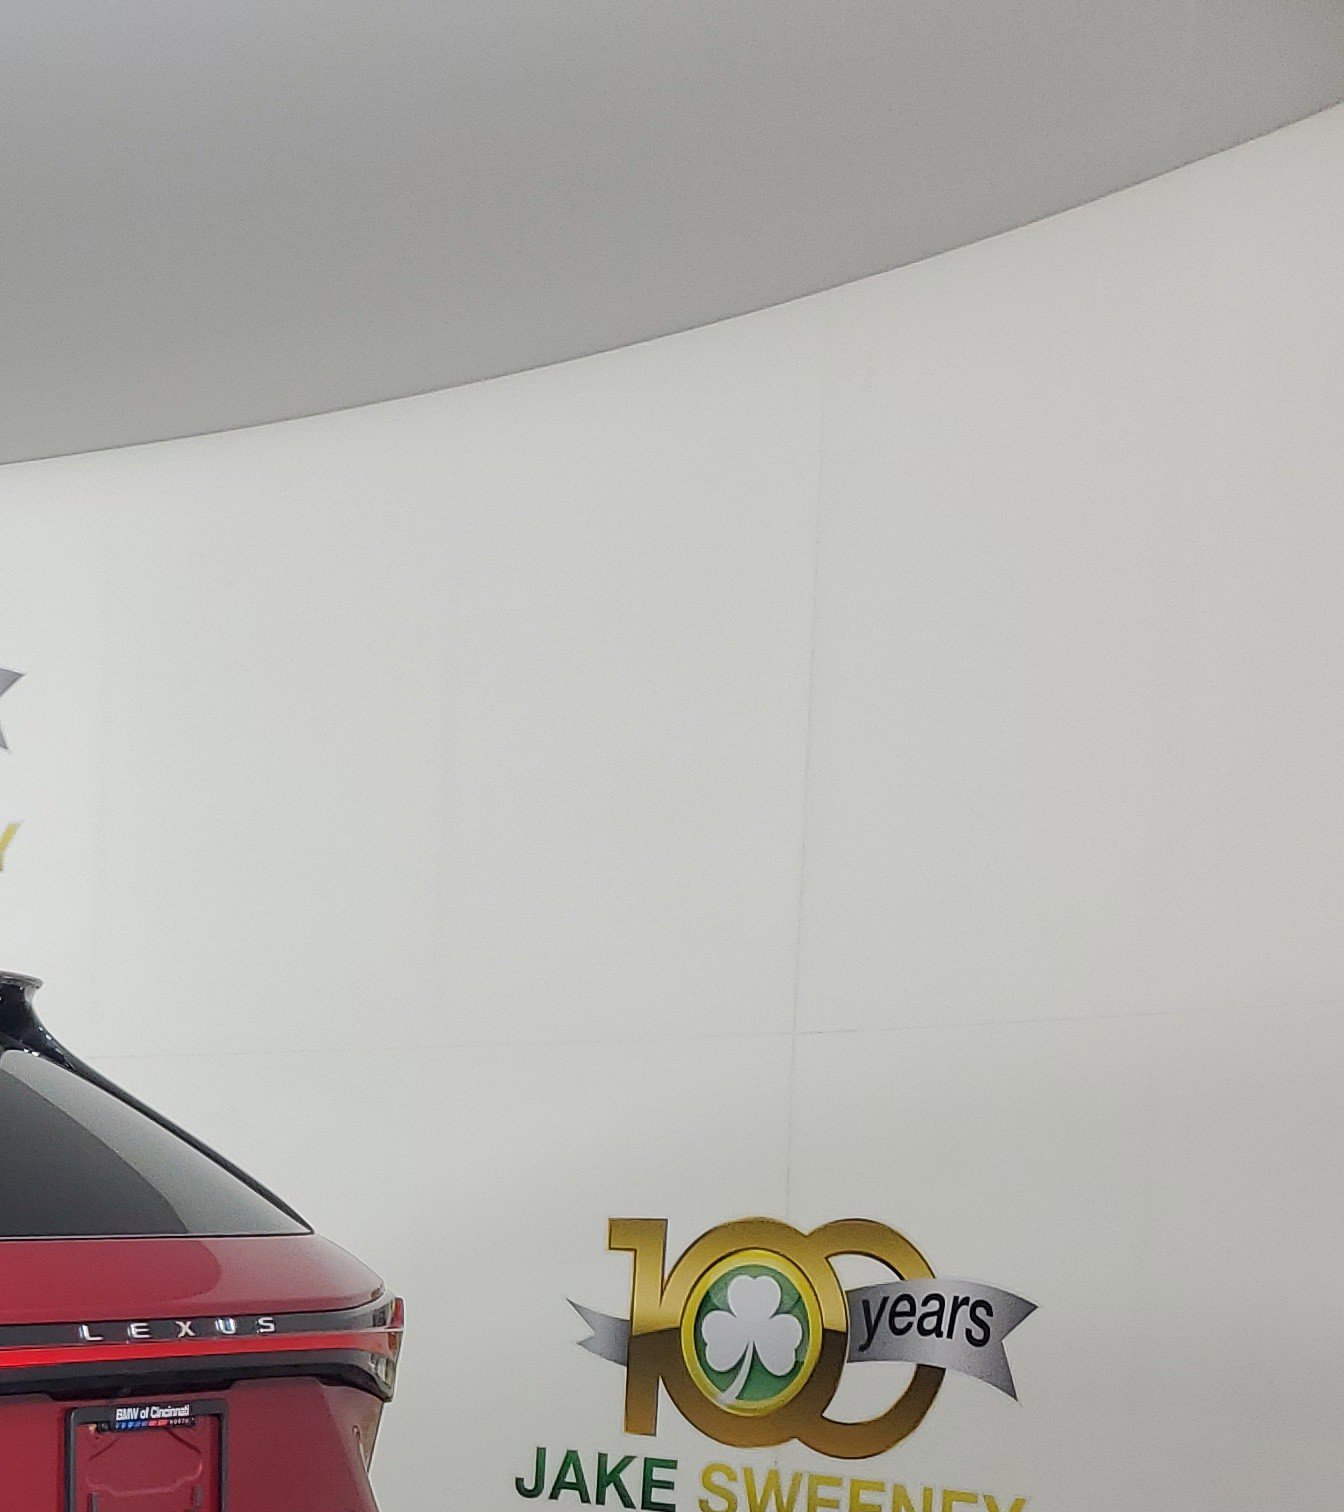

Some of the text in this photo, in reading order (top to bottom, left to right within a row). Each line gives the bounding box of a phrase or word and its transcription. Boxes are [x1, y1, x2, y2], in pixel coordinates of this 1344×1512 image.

[79, 1316, 276, 1341] LEXUS
[608, 1217, 946, 1460] 100
[858, 1292, 994, 1352] years
[115, 1404, 190, 1421] BMW of Cincinnati
